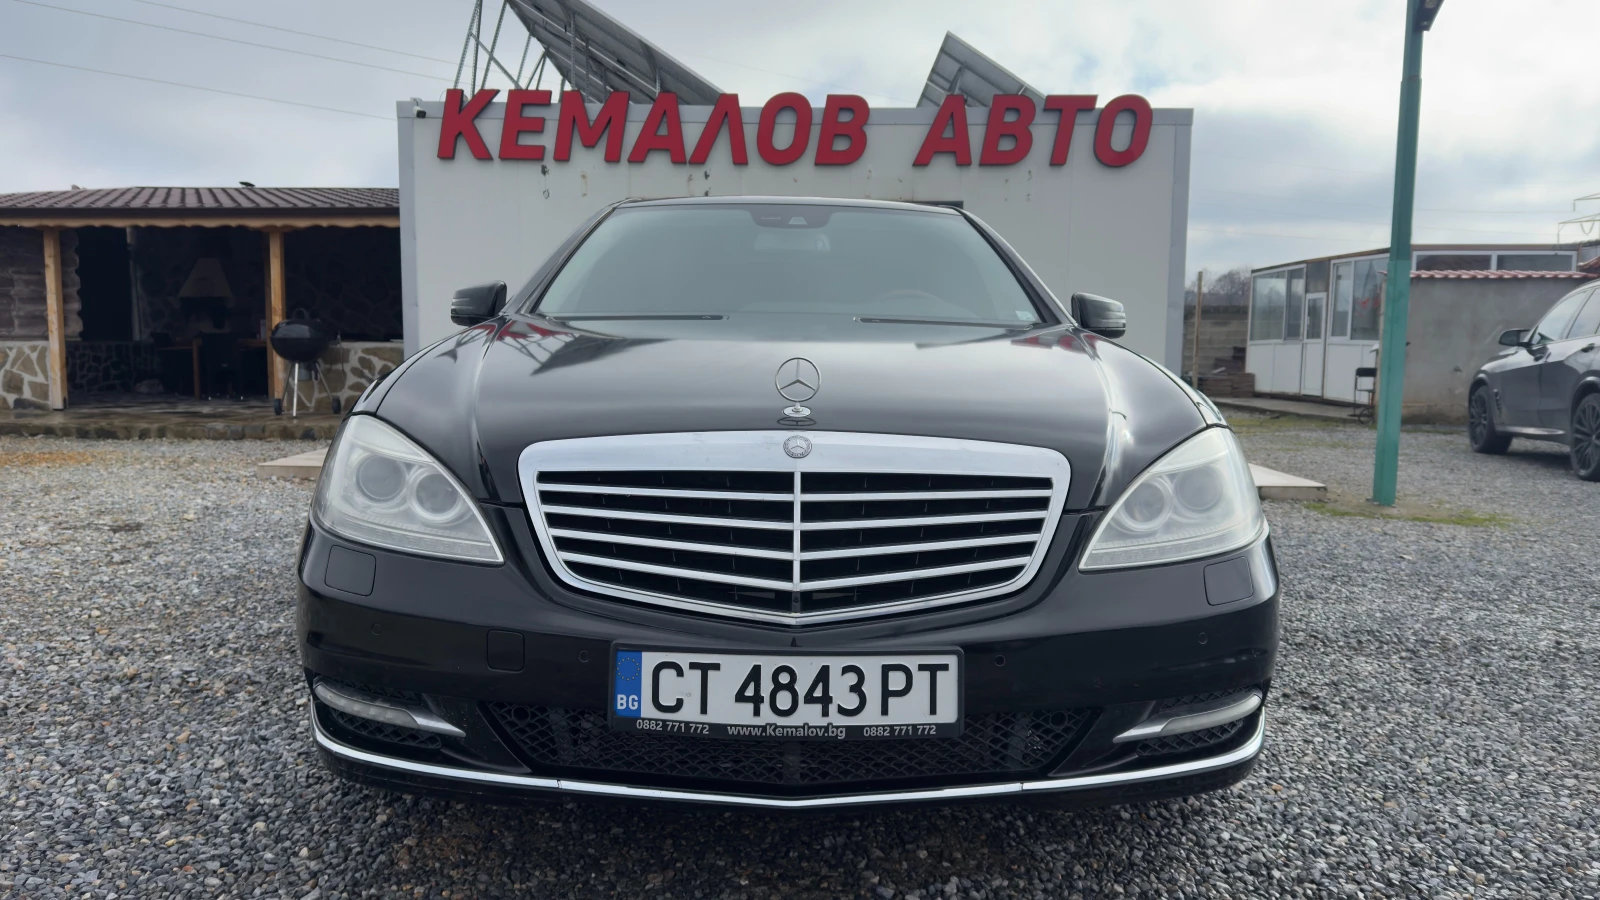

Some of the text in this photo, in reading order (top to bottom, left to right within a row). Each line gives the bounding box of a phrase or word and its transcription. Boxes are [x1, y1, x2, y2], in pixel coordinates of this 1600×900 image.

[437, 88, 1154, 168] КЕМАЛОВ АВТО
[651, 661, 950, 718] CT 4843 PT
[617, 694, 639, 711] BG
[636, 719, 709, 734] 0882 771 772
[727, 723, 846, 740] www.Kemalov.bg
[863, 725, 937, 737] 0882 771 772
